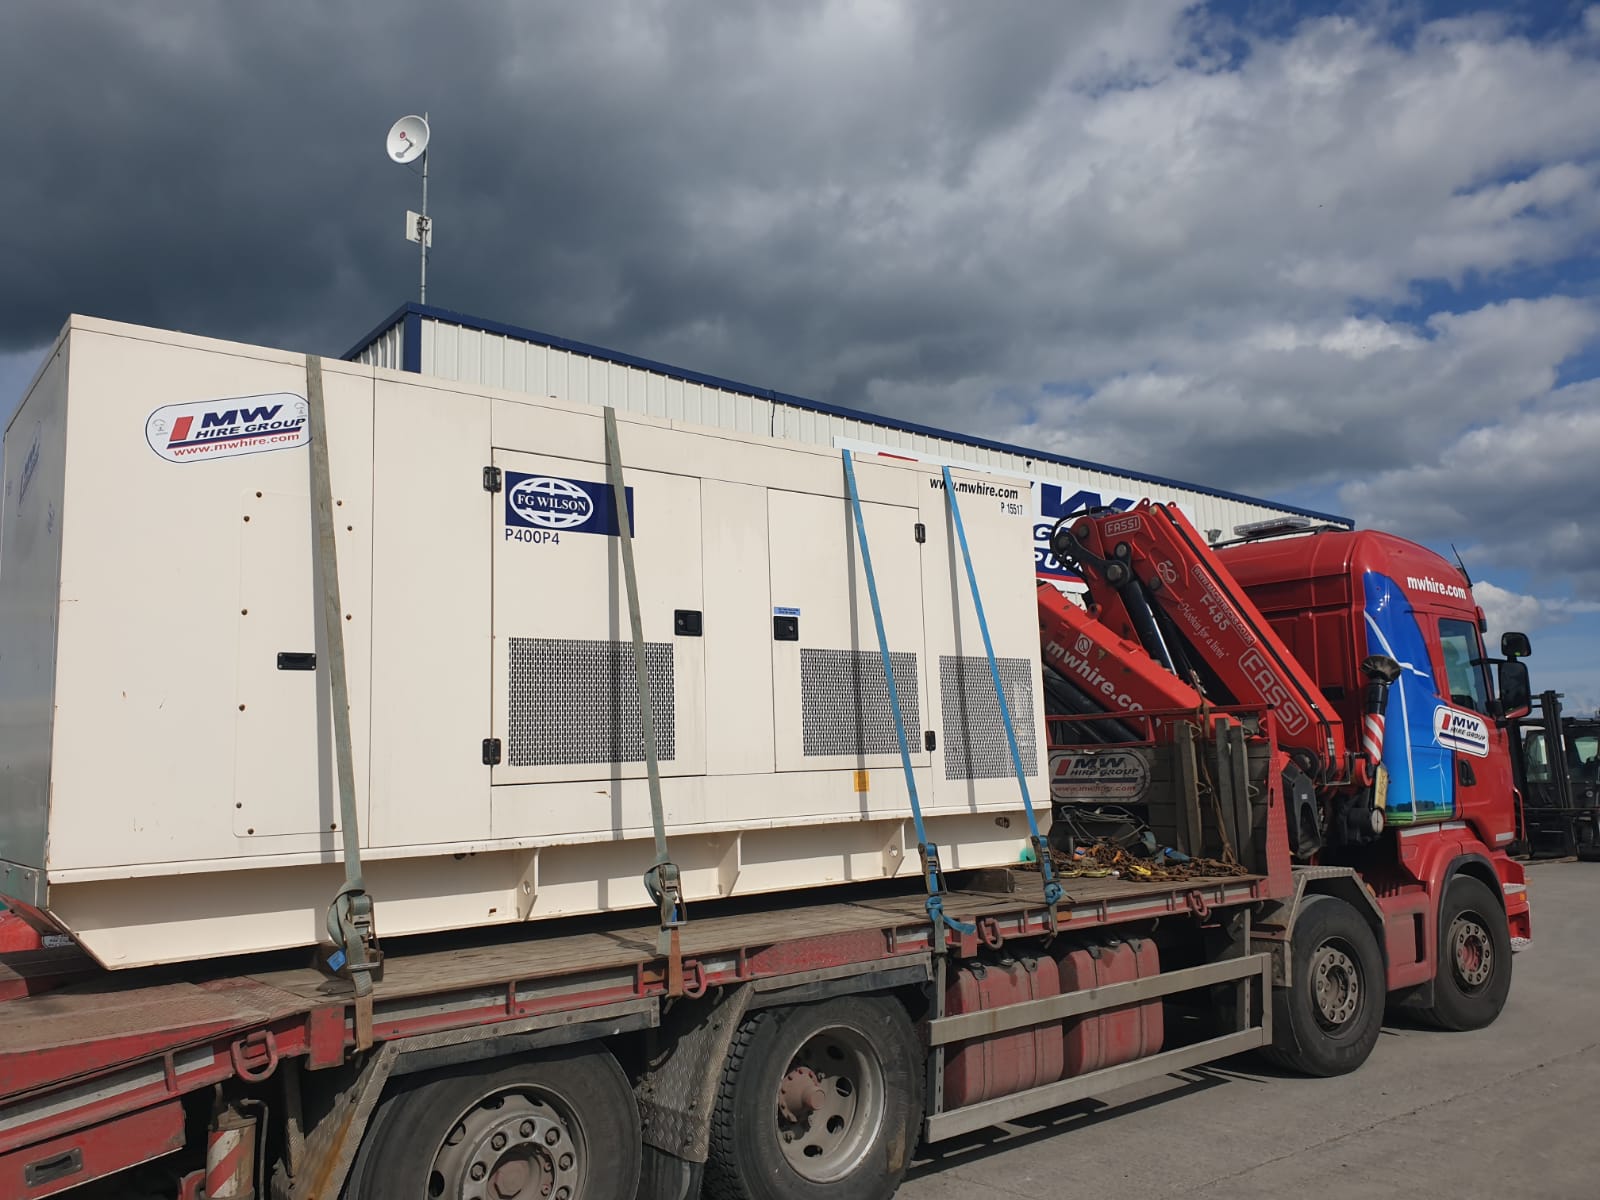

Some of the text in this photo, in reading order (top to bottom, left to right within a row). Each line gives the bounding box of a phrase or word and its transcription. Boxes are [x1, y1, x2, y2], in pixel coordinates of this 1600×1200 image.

[201, 404, 284, 429] MW
[195, 418, 306, 440] HIRE GROUP
[174, 433, 300, 456] www.mwhire.com
[517, 494, 587, 511] FG WILSON
[505, 528, 560, 545] P400P4
[1107, 518, 1138, 533] FASSI
[1407, 576, 1467, 600] mwhire.com
[1200, 593, 1231, 631] F485
[1244, 655, 1303, 729] FASSI
[1452, 716, 1479, 731] MW
[1074, 757, 1126, 769] MW
